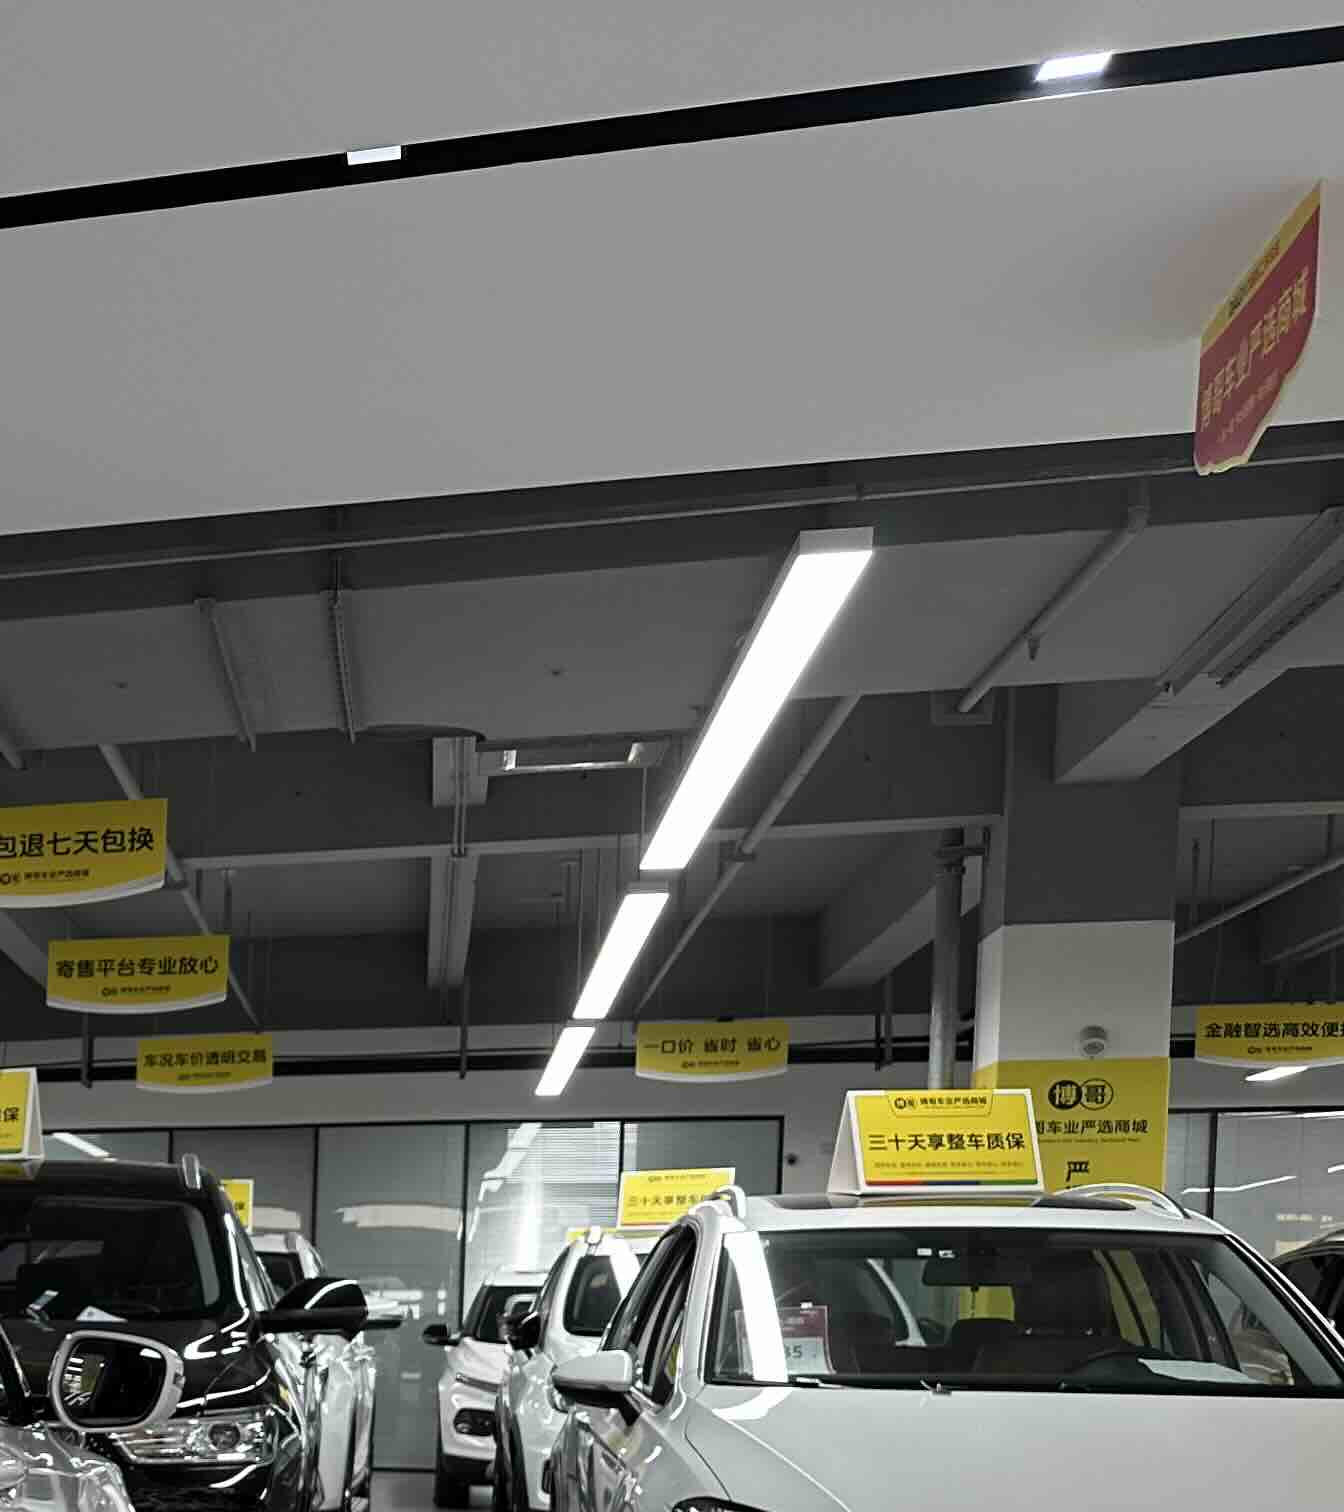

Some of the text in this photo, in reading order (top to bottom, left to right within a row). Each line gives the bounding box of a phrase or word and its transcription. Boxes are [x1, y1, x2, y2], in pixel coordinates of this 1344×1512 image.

[1205, 1022, 1344, 1039] 金融智选高效便
[868, 1132, 1026, 1151] 三十天享整车质保
